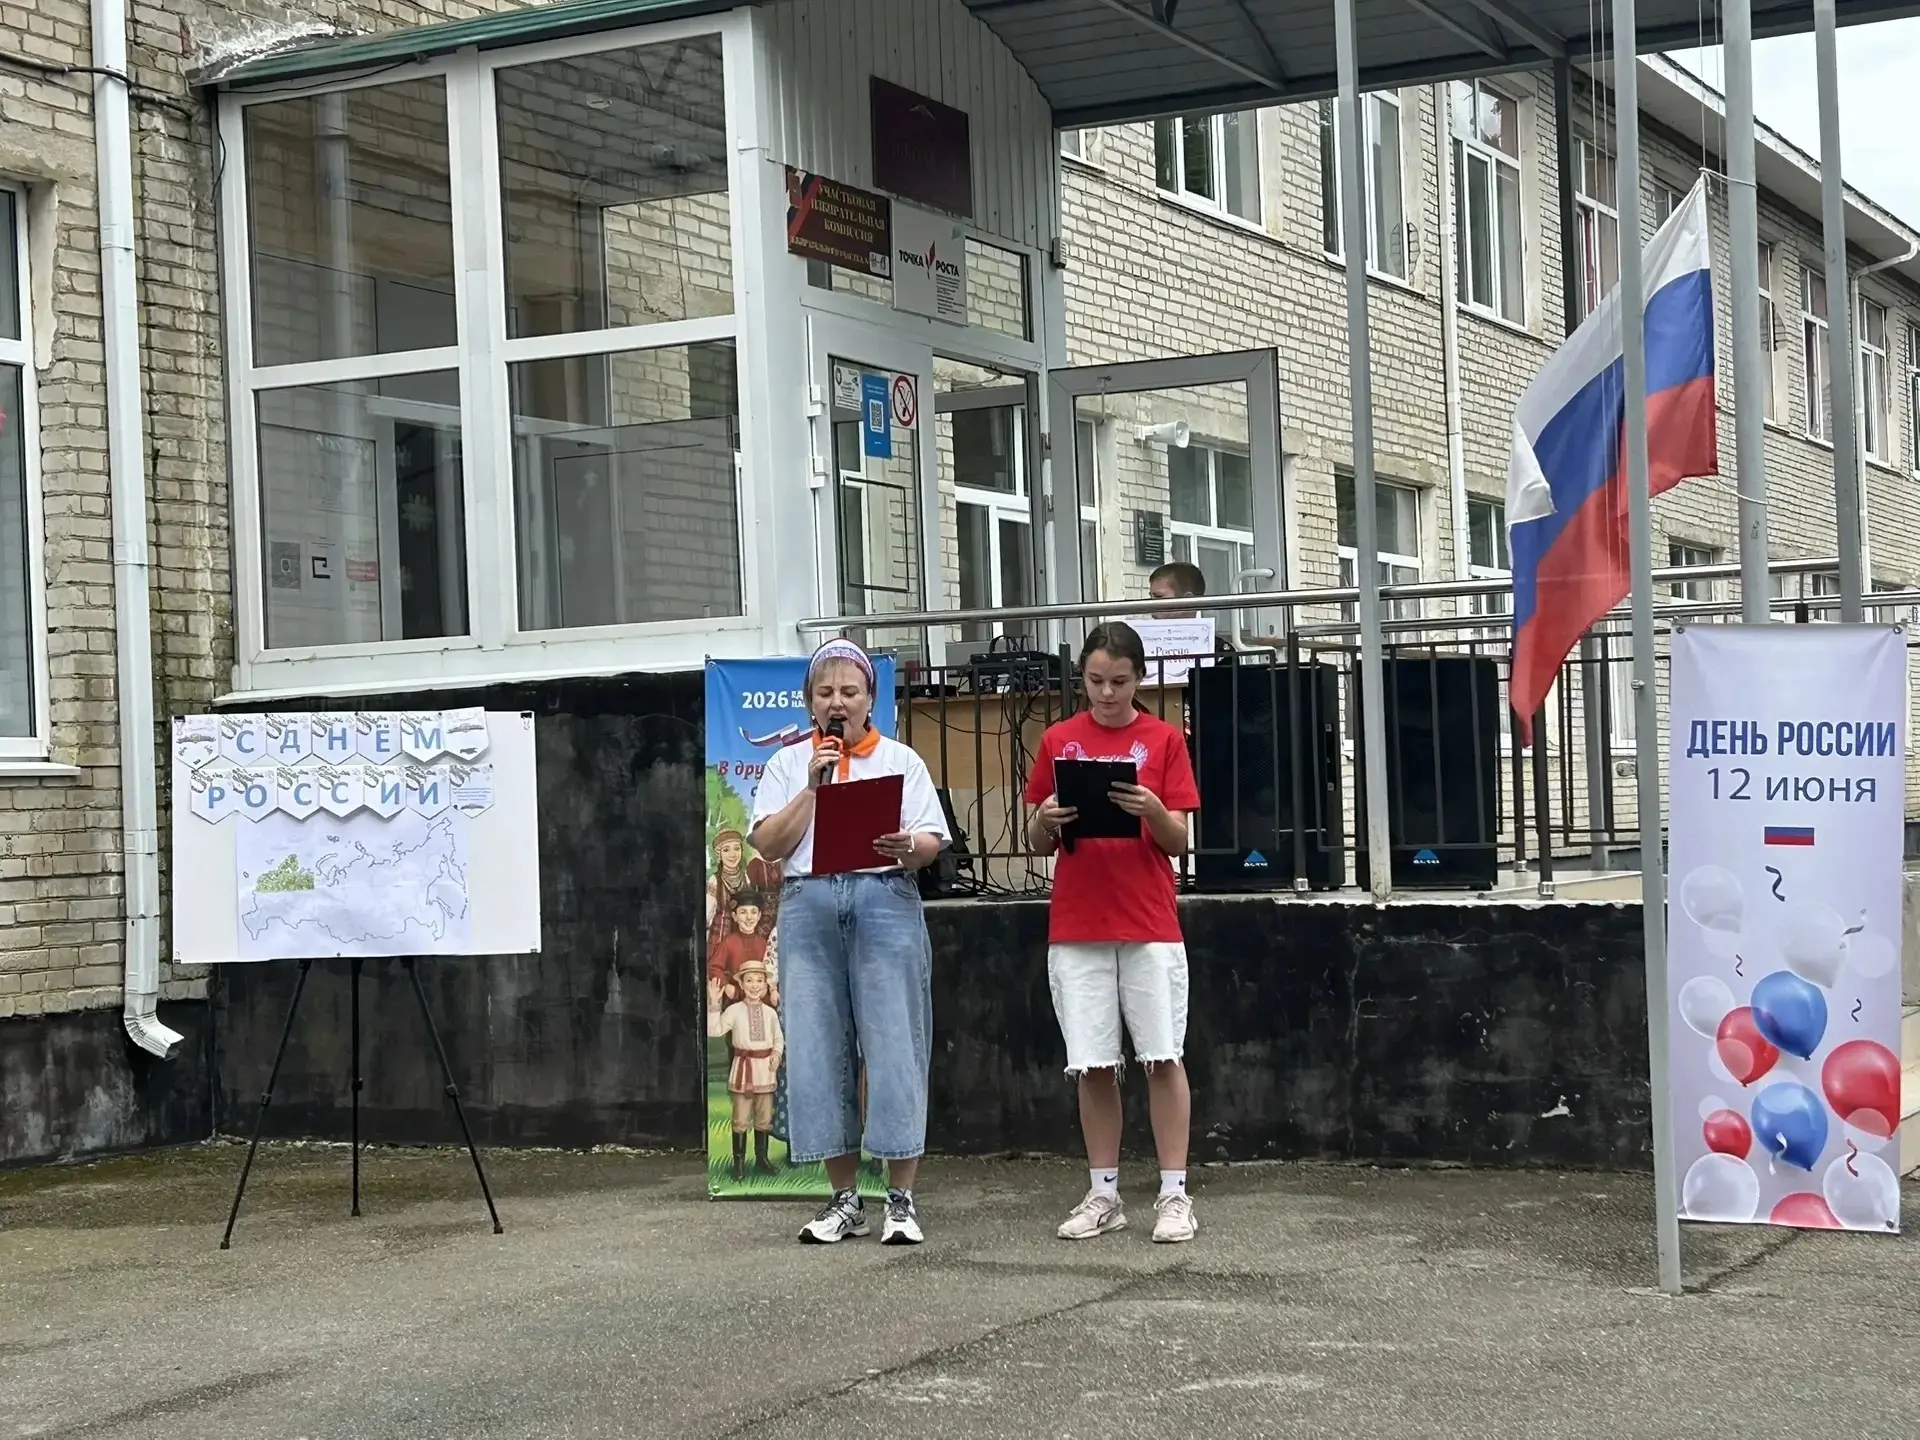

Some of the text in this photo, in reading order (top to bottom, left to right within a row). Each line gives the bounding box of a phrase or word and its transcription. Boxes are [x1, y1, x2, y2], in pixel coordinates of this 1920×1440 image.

[817, 184, 876, 212] УЧАСТКОВАЯ
[811, 197, 885, 231] ИЗБИРАТЕЛЬНАЯ
[824, 218, 873, 243] КОМИССИЯ
[899, 249, 924, 267] ТОЧКА
[936, 260, 959, 276] РОСТА
[742, 690, 789, 709] 2026
[236, 729, 255, 754] С
[1686, 720, 1896, 758] ДЕНЬ РОССИИ
[735, 760, 765, 780] дру
[208, 781, 439, 810] РОССИИ
[1706, 768, 1876, 803] 12 июня
